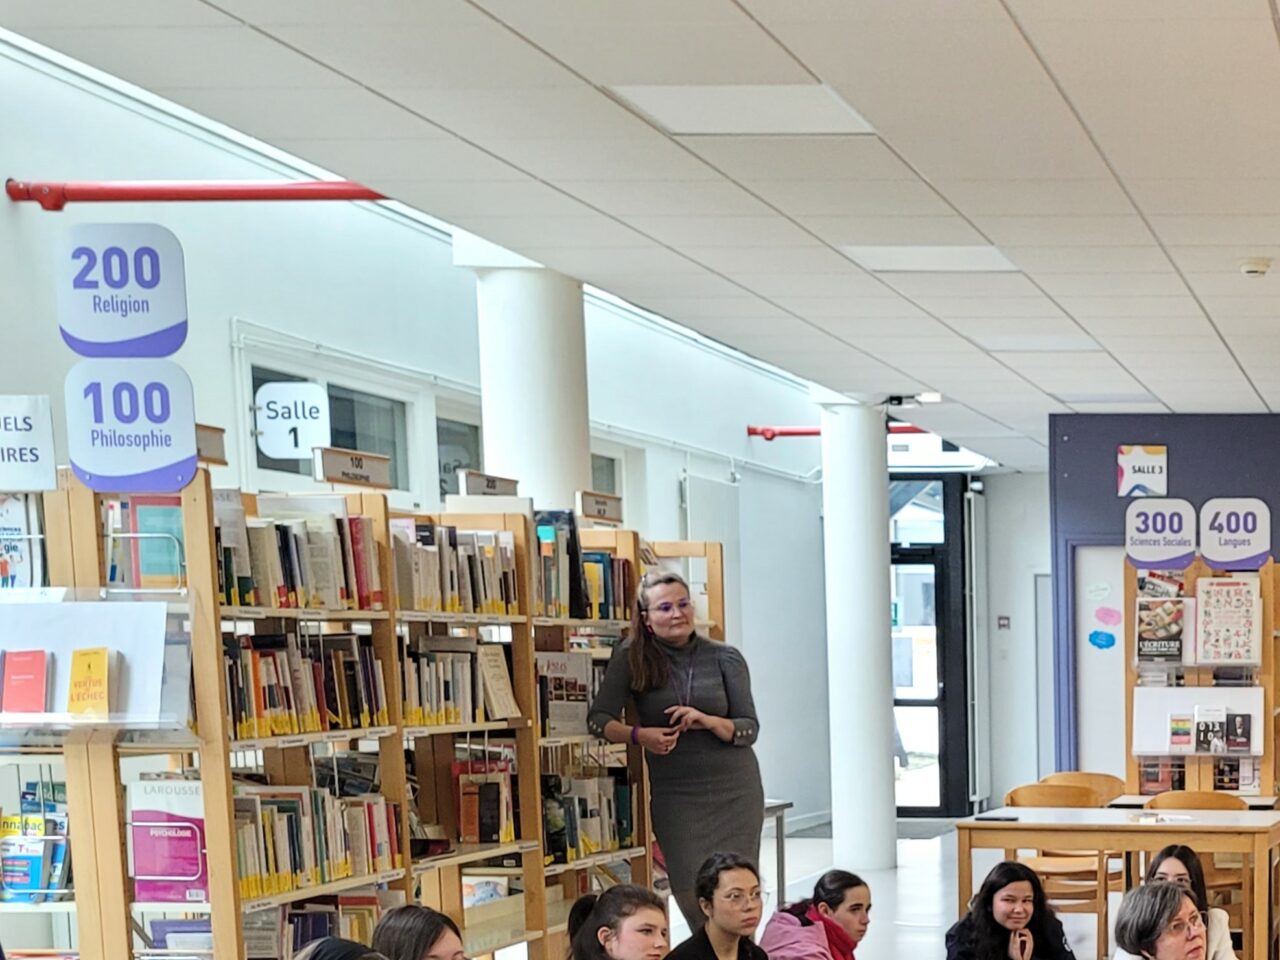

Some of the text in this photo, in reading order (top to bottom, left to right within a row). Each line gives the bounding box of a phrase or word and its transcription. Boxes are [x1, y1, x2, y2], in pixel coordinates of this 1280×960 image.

[71, 246, 161, 290] 200
[93, 295, 150, 318] Religion
[83, 382, 171, 424] 100
[265, 400, 321, 421] Salle
[0, 415, 33, 432] ELS
[91, 428, 172, 452] Philosophie
[288, 426, 299, 448] 1
[1131, 465, 1163, 475] SALLE 3
[1135, 511, 1183, 534] 300
[1208, 511, 1257, 534] 400
[1130, 536, 1192, 548] Sciences Sociales
[1218, 537, 1251, 549] Langues
[143, 785, 201, 796] LAROUSSE
